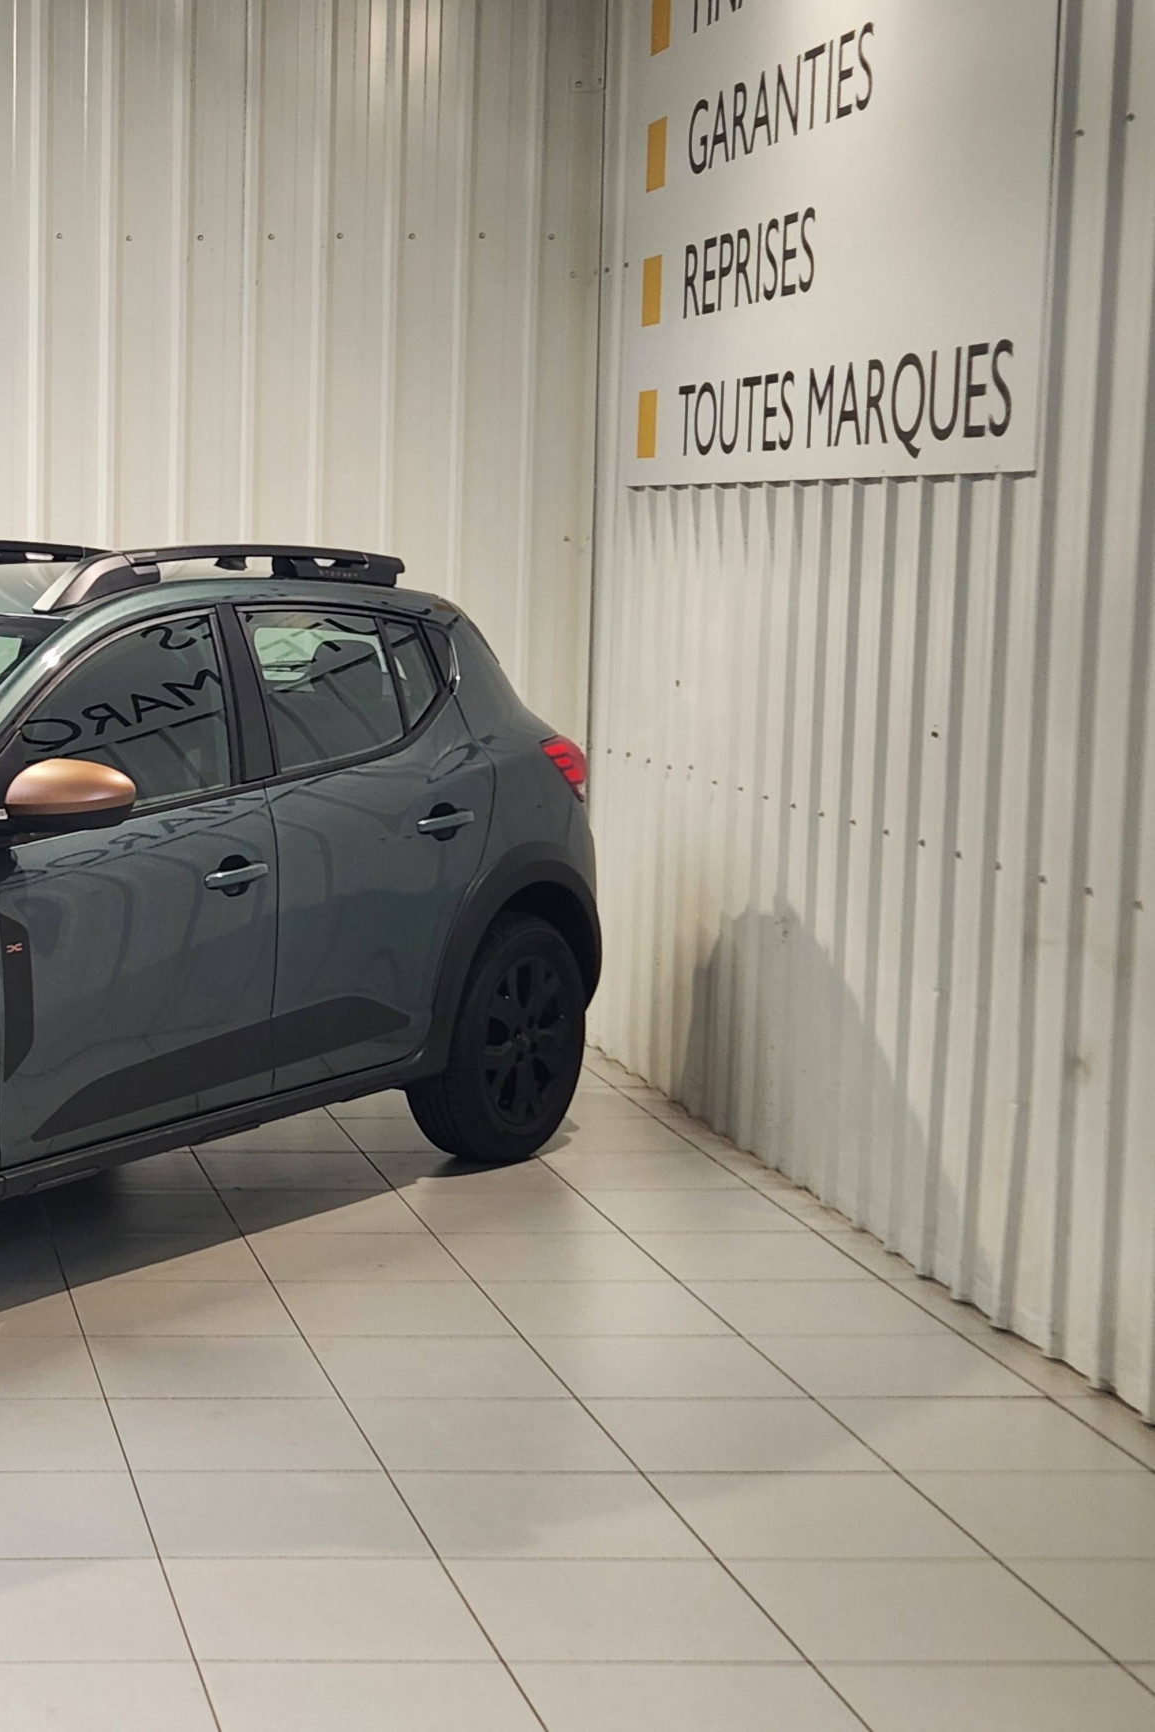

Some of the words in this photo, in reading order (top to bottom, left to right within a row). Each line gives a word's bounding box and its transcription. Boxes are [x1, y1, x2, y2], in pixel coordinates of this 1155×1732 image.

[688, 21, 875, 175] GARANTIES
[682, 206, 816, 320] REPRISES
[678, 370, 795, 457] TOUTES
[806, 338, 1014, 459] MARQUES
